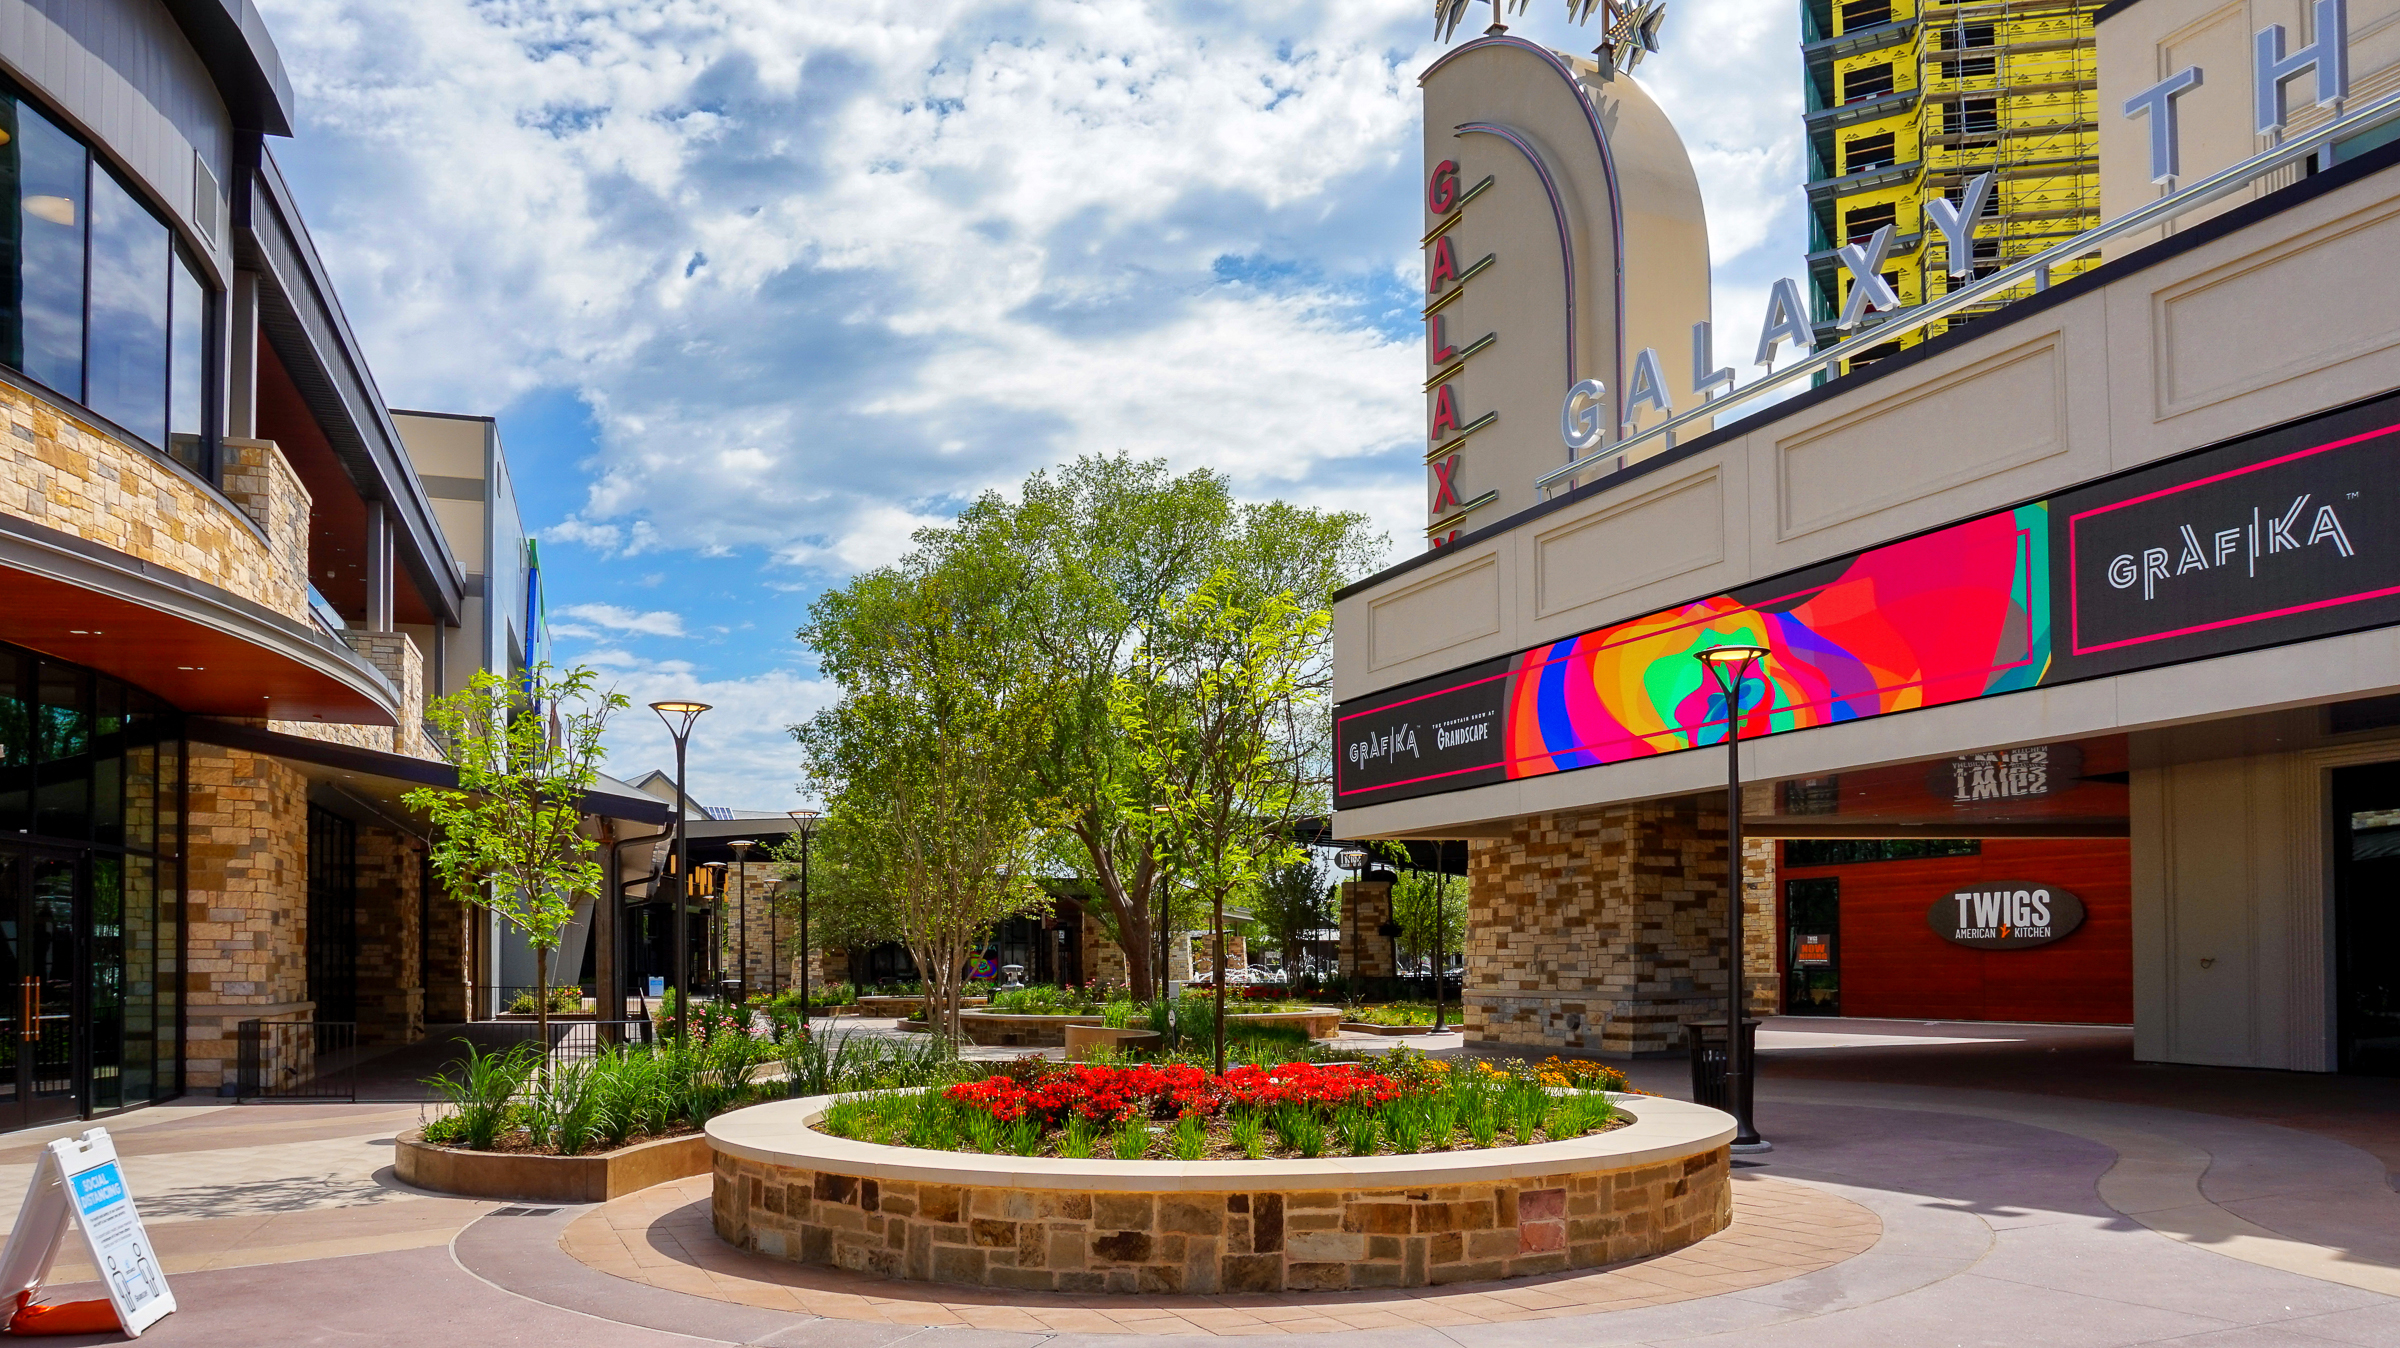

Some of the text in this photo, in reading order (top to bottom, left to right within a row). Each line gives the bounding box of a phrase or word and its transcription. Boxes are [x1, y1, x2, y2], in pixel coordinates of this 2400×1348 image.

[1561, 171, 1997, 449] GALAXY
[2107, 493, 2355, 601] GRAFIKA
[1349, 723, 1420, 770] GRAFIKA
[1954, 889, 2051, 928] TWIGS
[1801, 944, 1825, 953] NOW
[1955, 926, 2051, 939] AMERICAN KITCHEN
[80, 1182, 122, 1209] DISTANCING
[82, 1173, 109, 1192] SOCIAL
